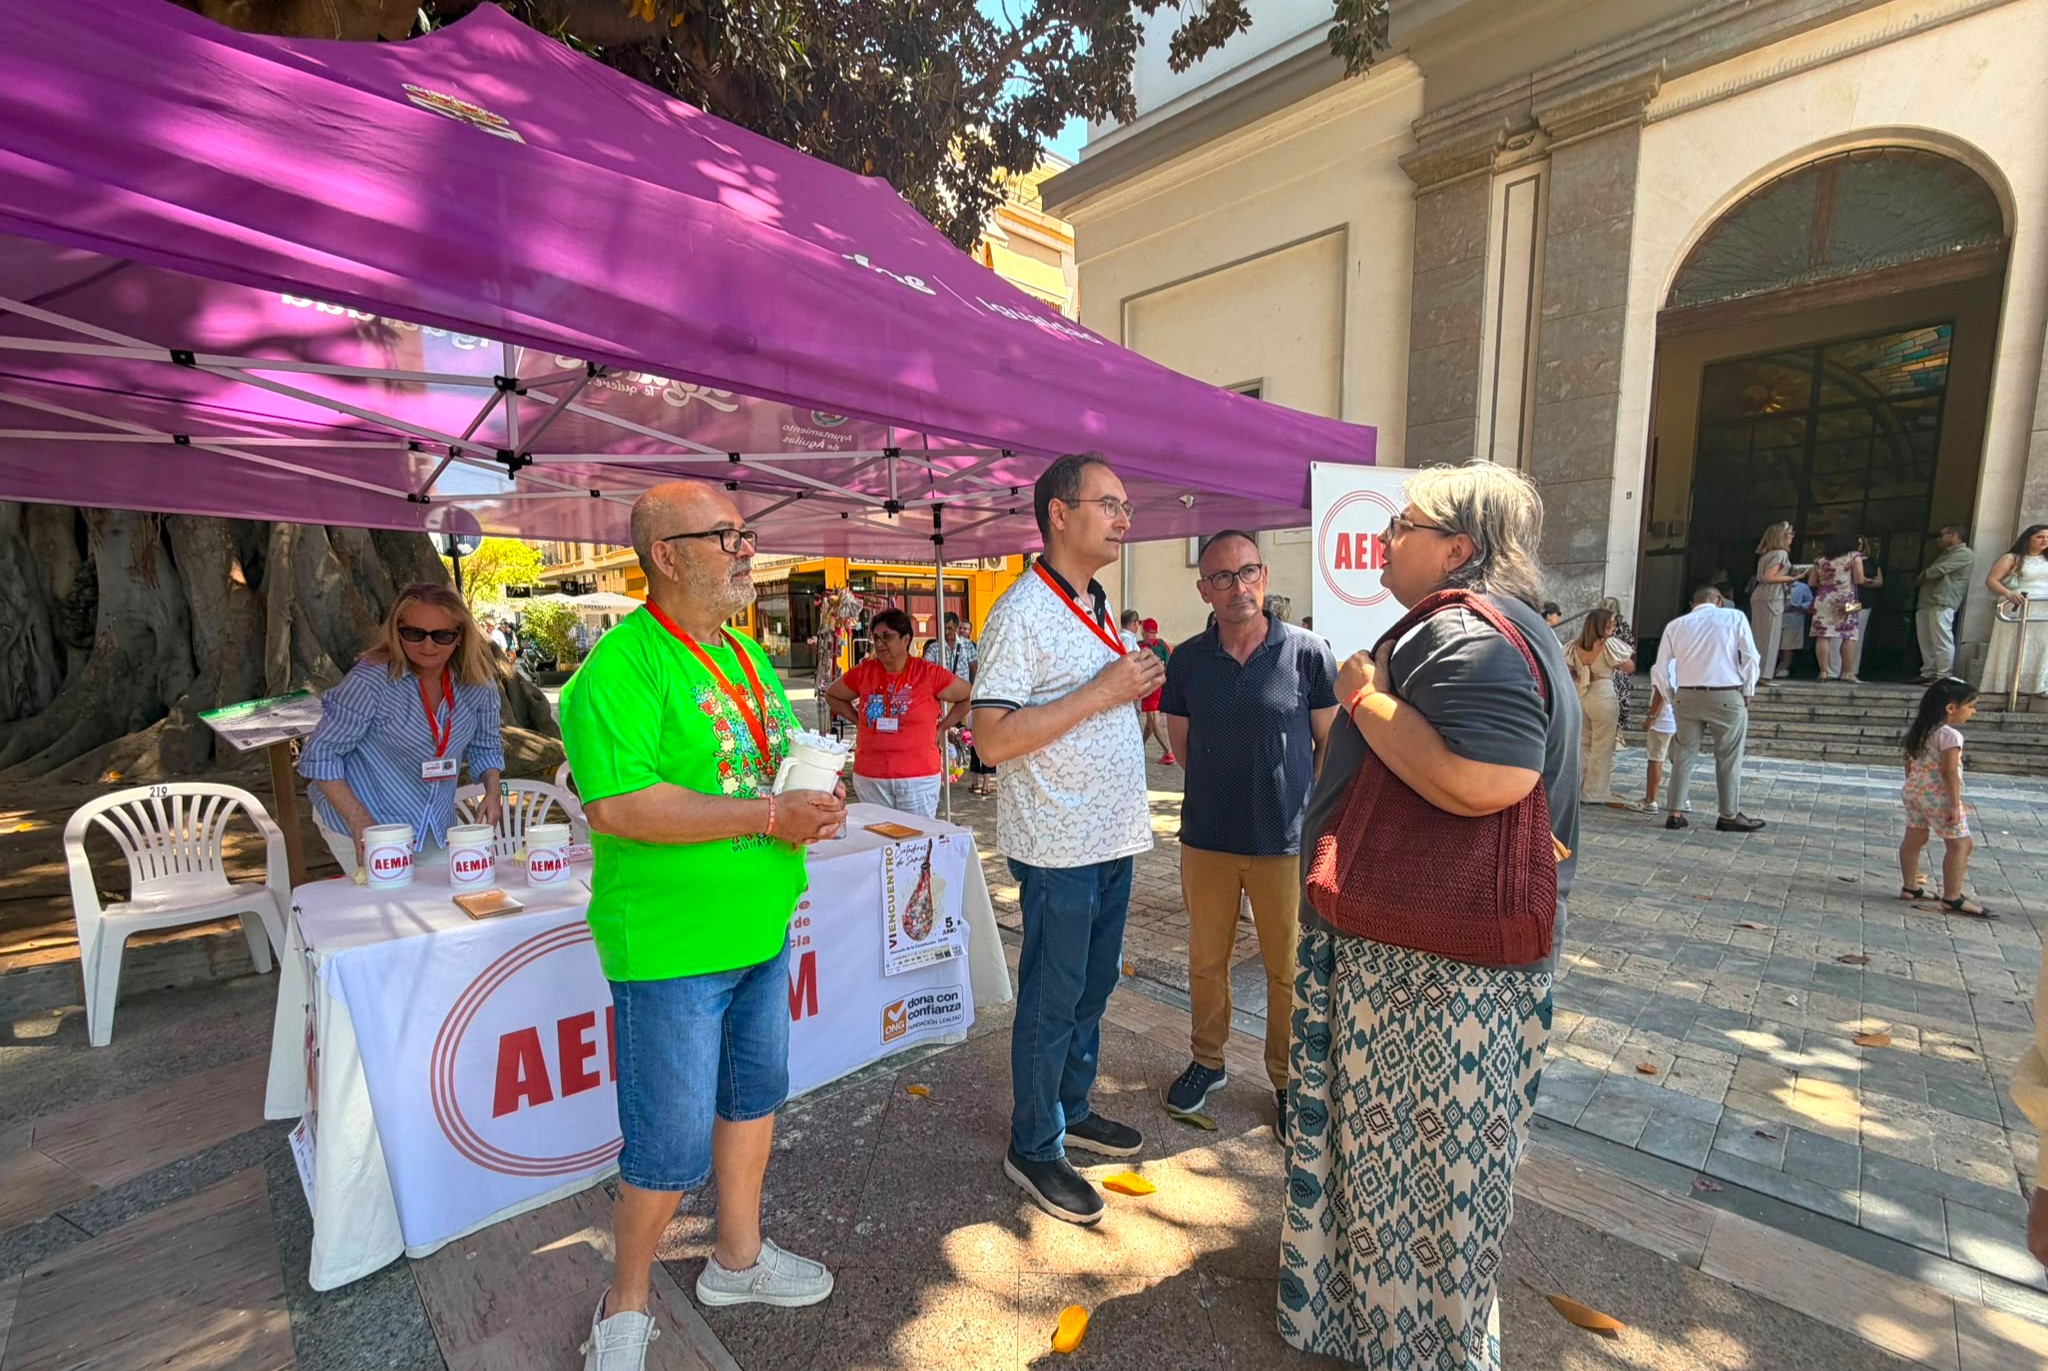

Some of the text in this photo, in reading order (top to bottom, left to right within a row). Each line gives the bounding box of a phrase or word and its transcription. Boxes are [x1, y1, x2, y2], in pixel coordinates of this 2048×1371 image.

[149, 786, 168, 798] 219
[945, 916, 953, 928] 5
[907, 991, 959, 1009] dona con
[907, 1001, 962, 1020] confianza
[885, 1020, 905, 1035] ONG
